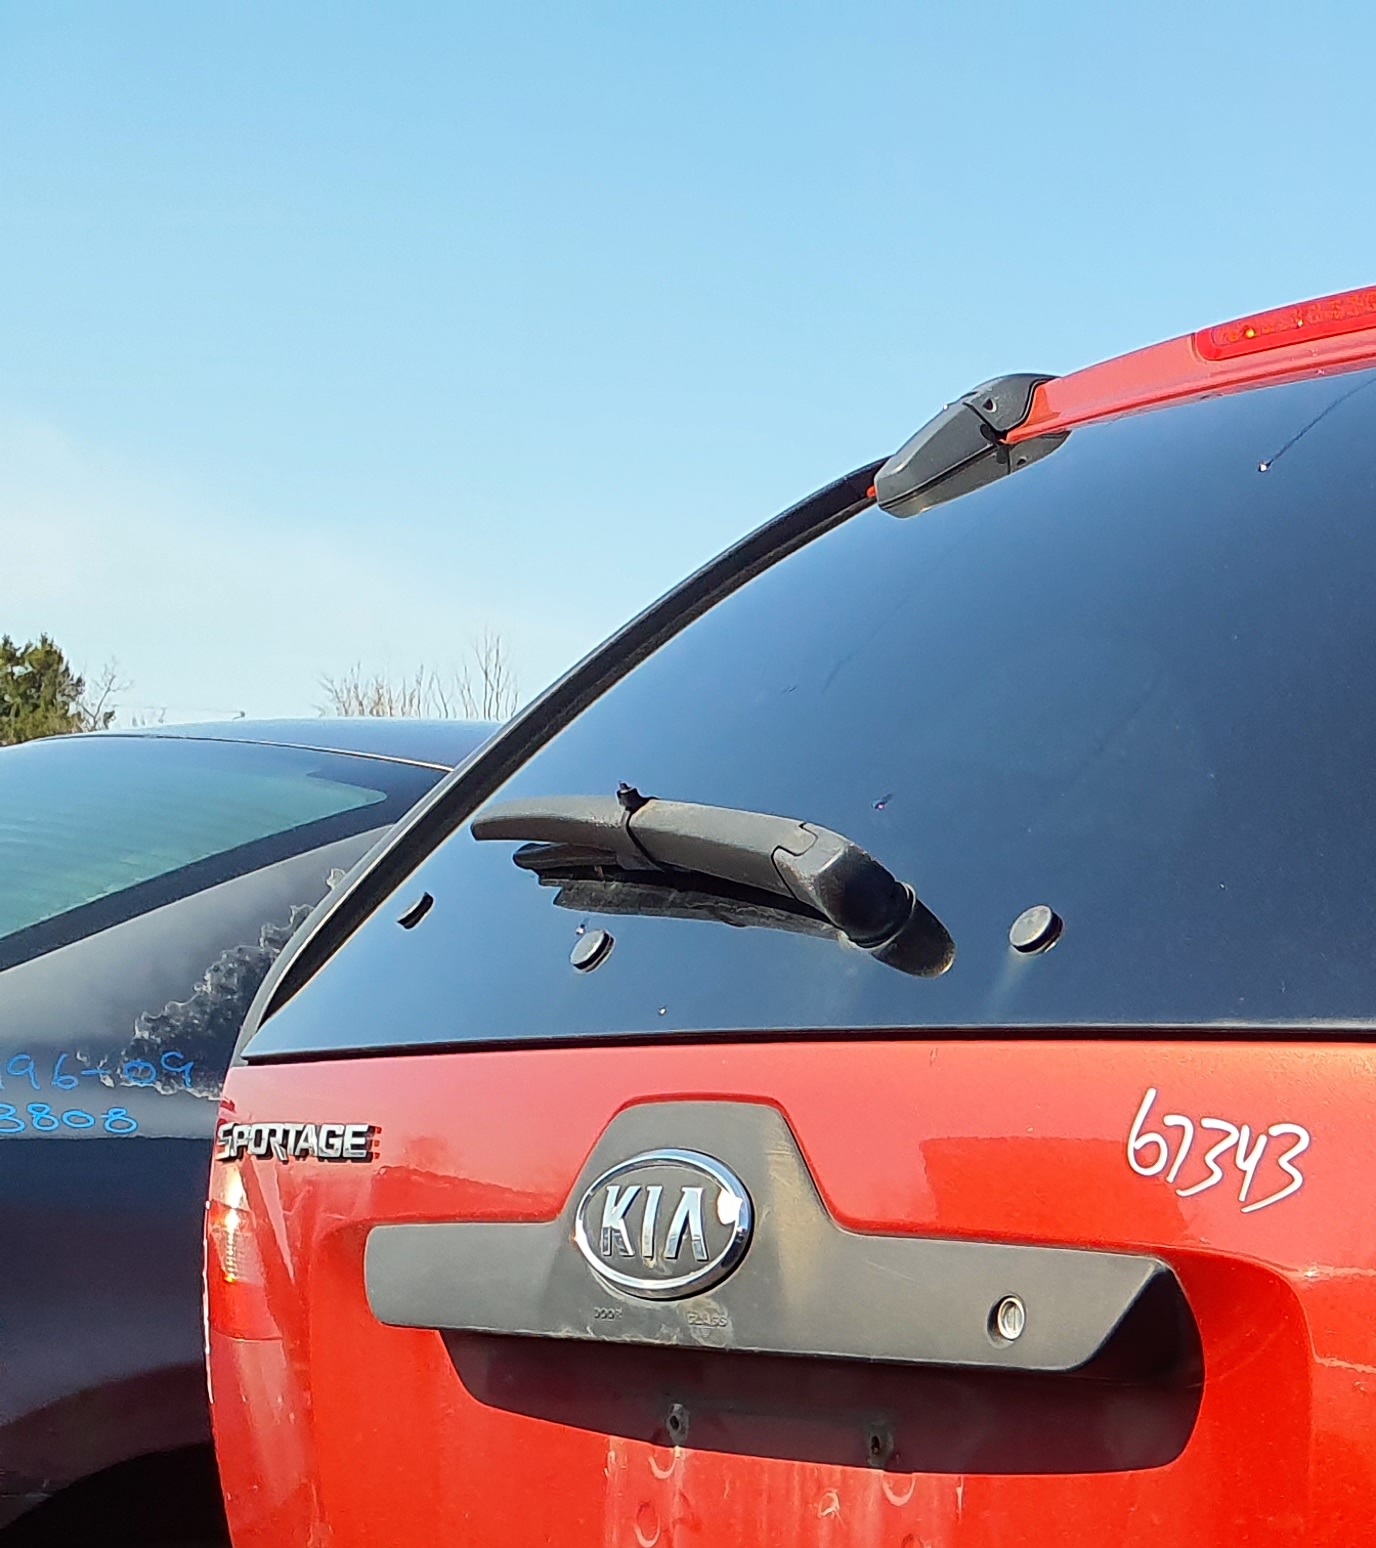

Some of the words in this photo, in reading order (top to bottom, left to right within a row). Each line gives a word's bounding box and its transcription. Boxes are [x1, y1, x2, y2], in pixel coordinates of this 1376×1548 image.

[214, 1122, 374, 1162] SPORTAGE
[1126, 1087, 1311, 1214] 67343
[600, 1184, 710, 1262] KIA
